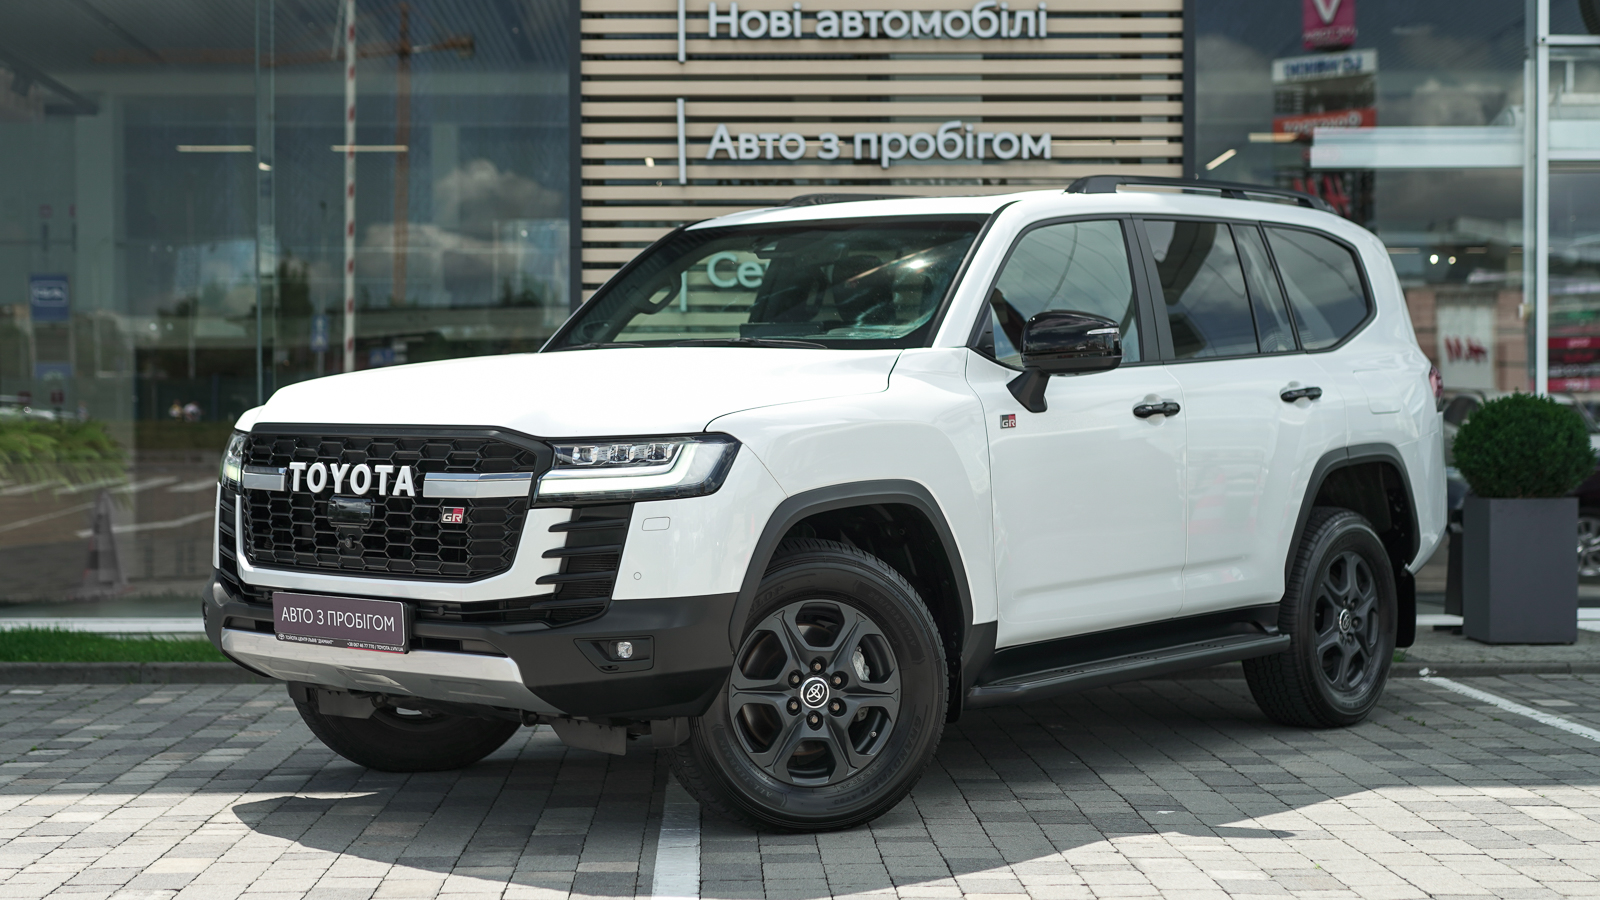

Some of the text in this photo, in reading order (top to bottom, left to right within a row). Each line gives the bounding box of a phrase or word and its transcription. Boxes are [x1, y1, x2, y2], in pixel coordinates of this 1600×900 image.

[707, 0, 1048, 40] Нові автомобілі
[705, 119, 1053, 169] Авто з пробігом
[1002, 419, 1015, 427] GR
[288, 461, 416, 497] TOYOTA
[442, 512, 463, 524] GR
[281, 606, 395, 632] АВТО З ПРОБІГОМ
